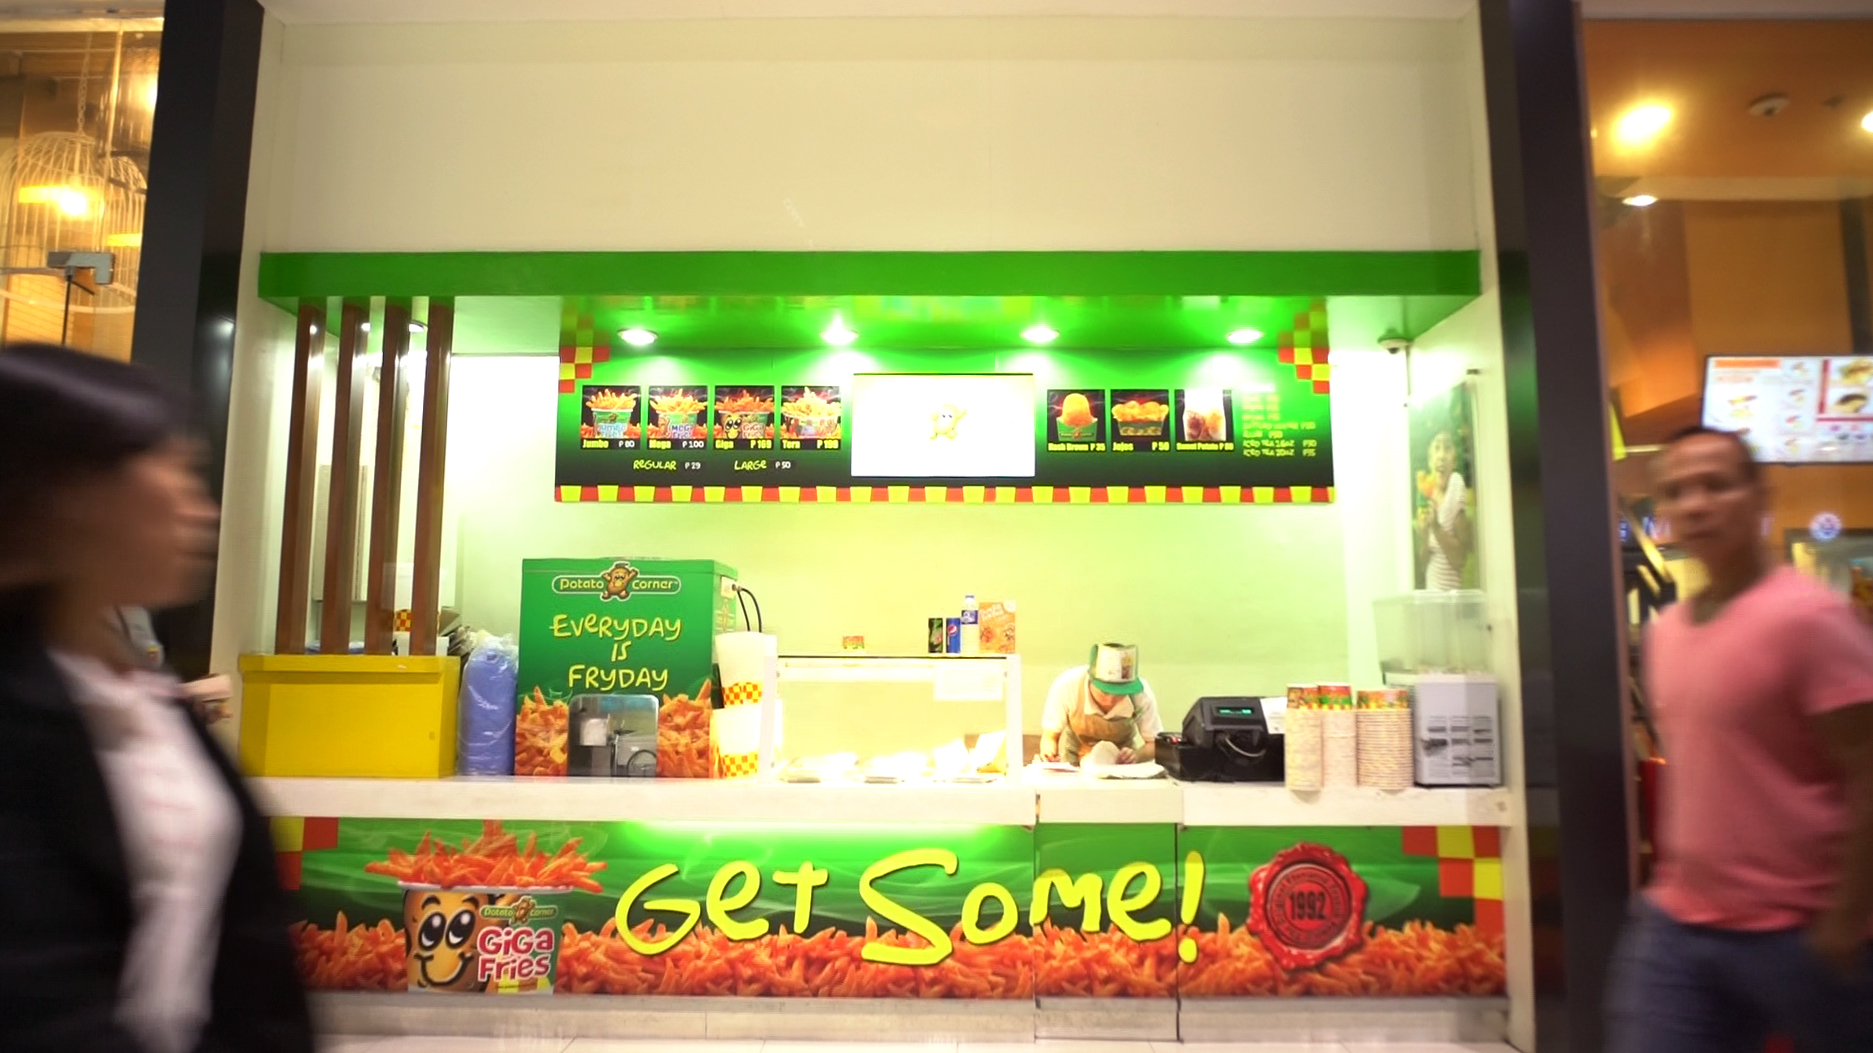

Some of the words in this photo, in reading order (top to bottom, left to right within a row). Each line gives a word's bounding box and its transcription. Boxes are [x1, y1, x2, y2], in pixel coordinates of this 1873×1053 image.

[582, 438, 609, 448] Jumbo
[648, 439, 671, 449] Mega
[688, 440, 704, 448] 100
[715, 439, 734, 449] Giga
[691, 461, 701, 470] 29
[781, 461, 791, 469] 50
[560, 578, 604, 590] Potato
[1290, 890, 1326, 920] 1992
[478, 954, 551, 982] Fries
